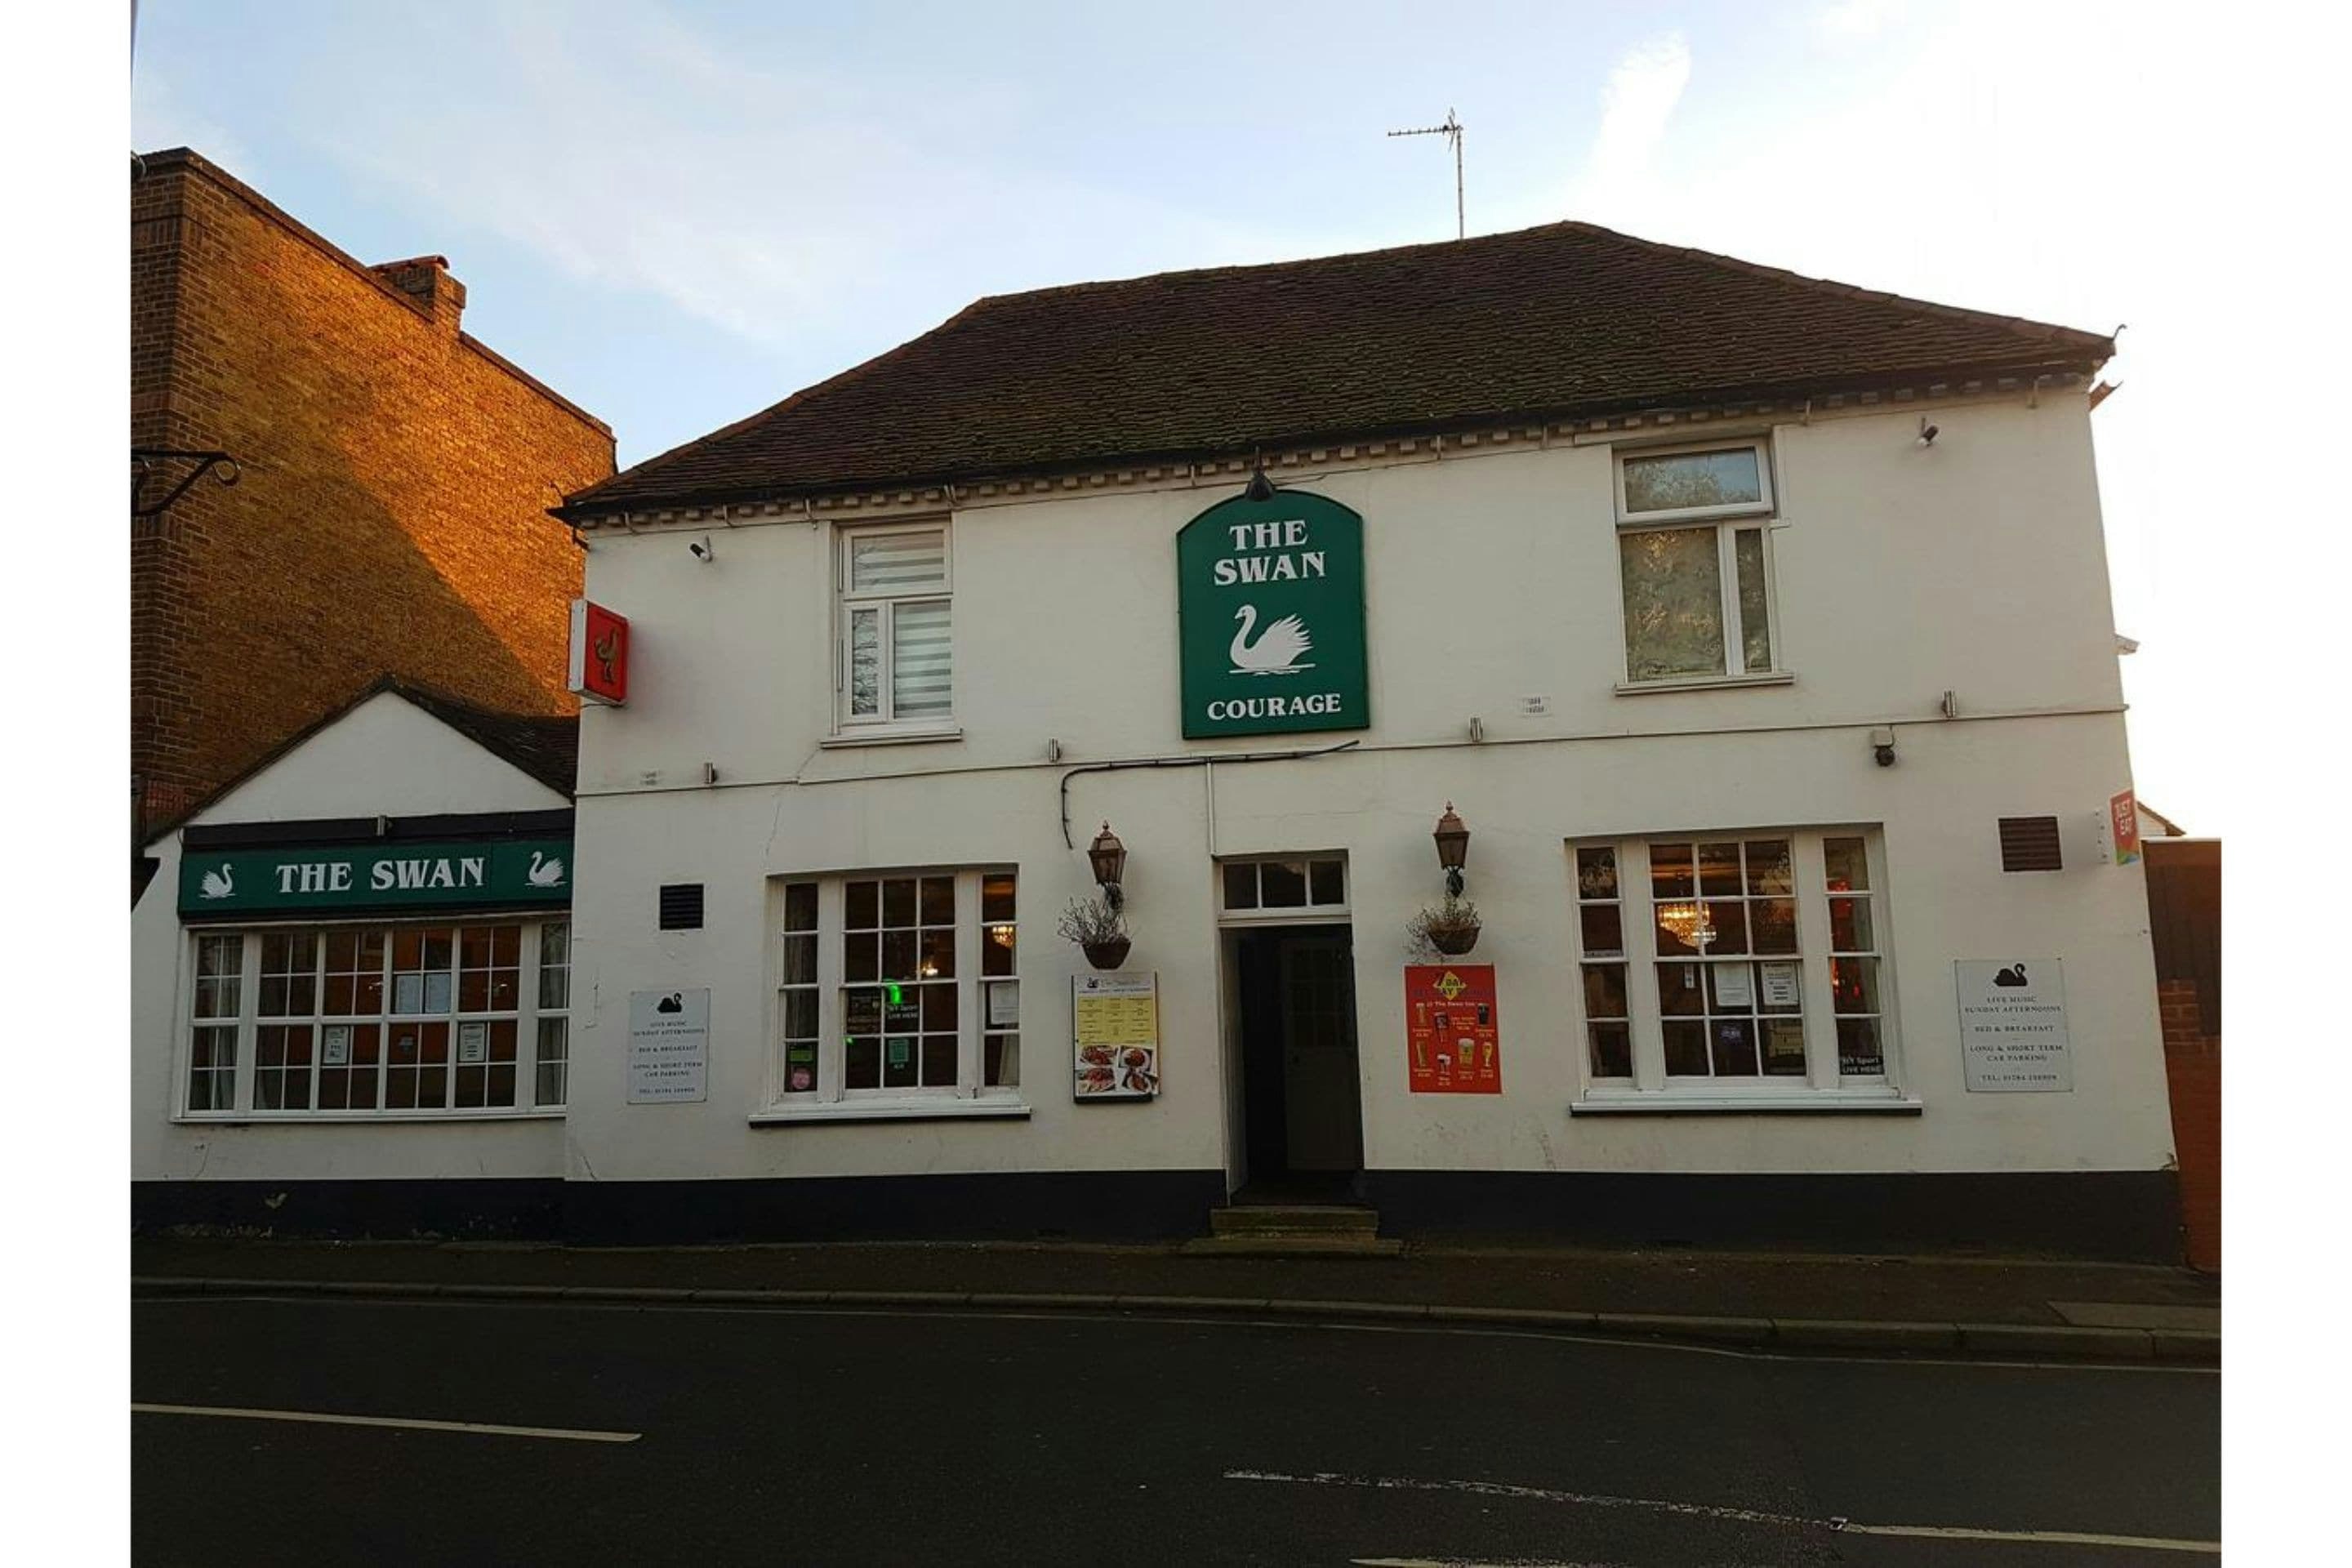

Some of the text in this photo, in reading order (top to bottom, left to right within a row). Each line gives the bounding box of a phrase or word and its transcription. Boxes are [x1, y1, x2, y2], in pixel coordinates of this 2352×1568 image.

[1229, 519, 1308, 551] THE
[1214, 551, 1326, 586] SWAN
[1207, 693, 1342, 720] COURAGE
[275, 858, 484, 893] THE SWAN
